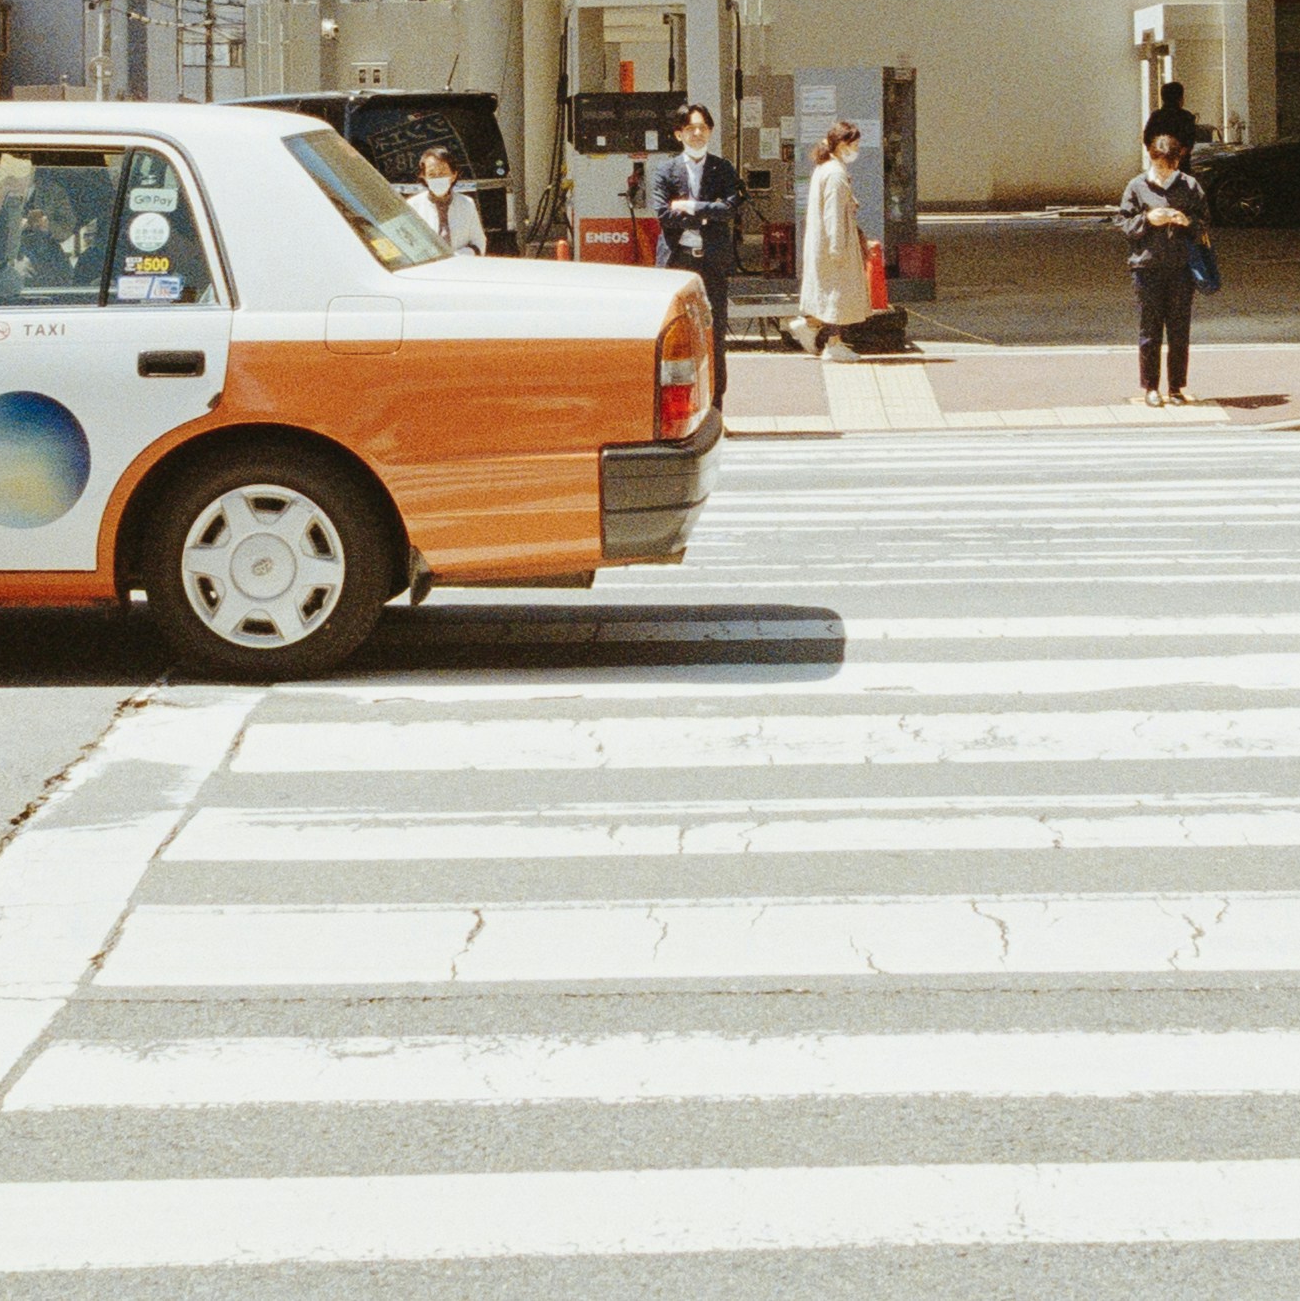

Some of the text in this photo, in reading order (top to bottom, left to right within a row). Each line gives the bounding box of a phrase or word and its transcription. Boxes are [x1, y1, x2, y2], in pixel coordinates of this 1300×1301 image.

[153, 195, 173, 207] Pay
[585, 232, 630, 244] ENEOS
[23, 323, 66, 336] TAXI
